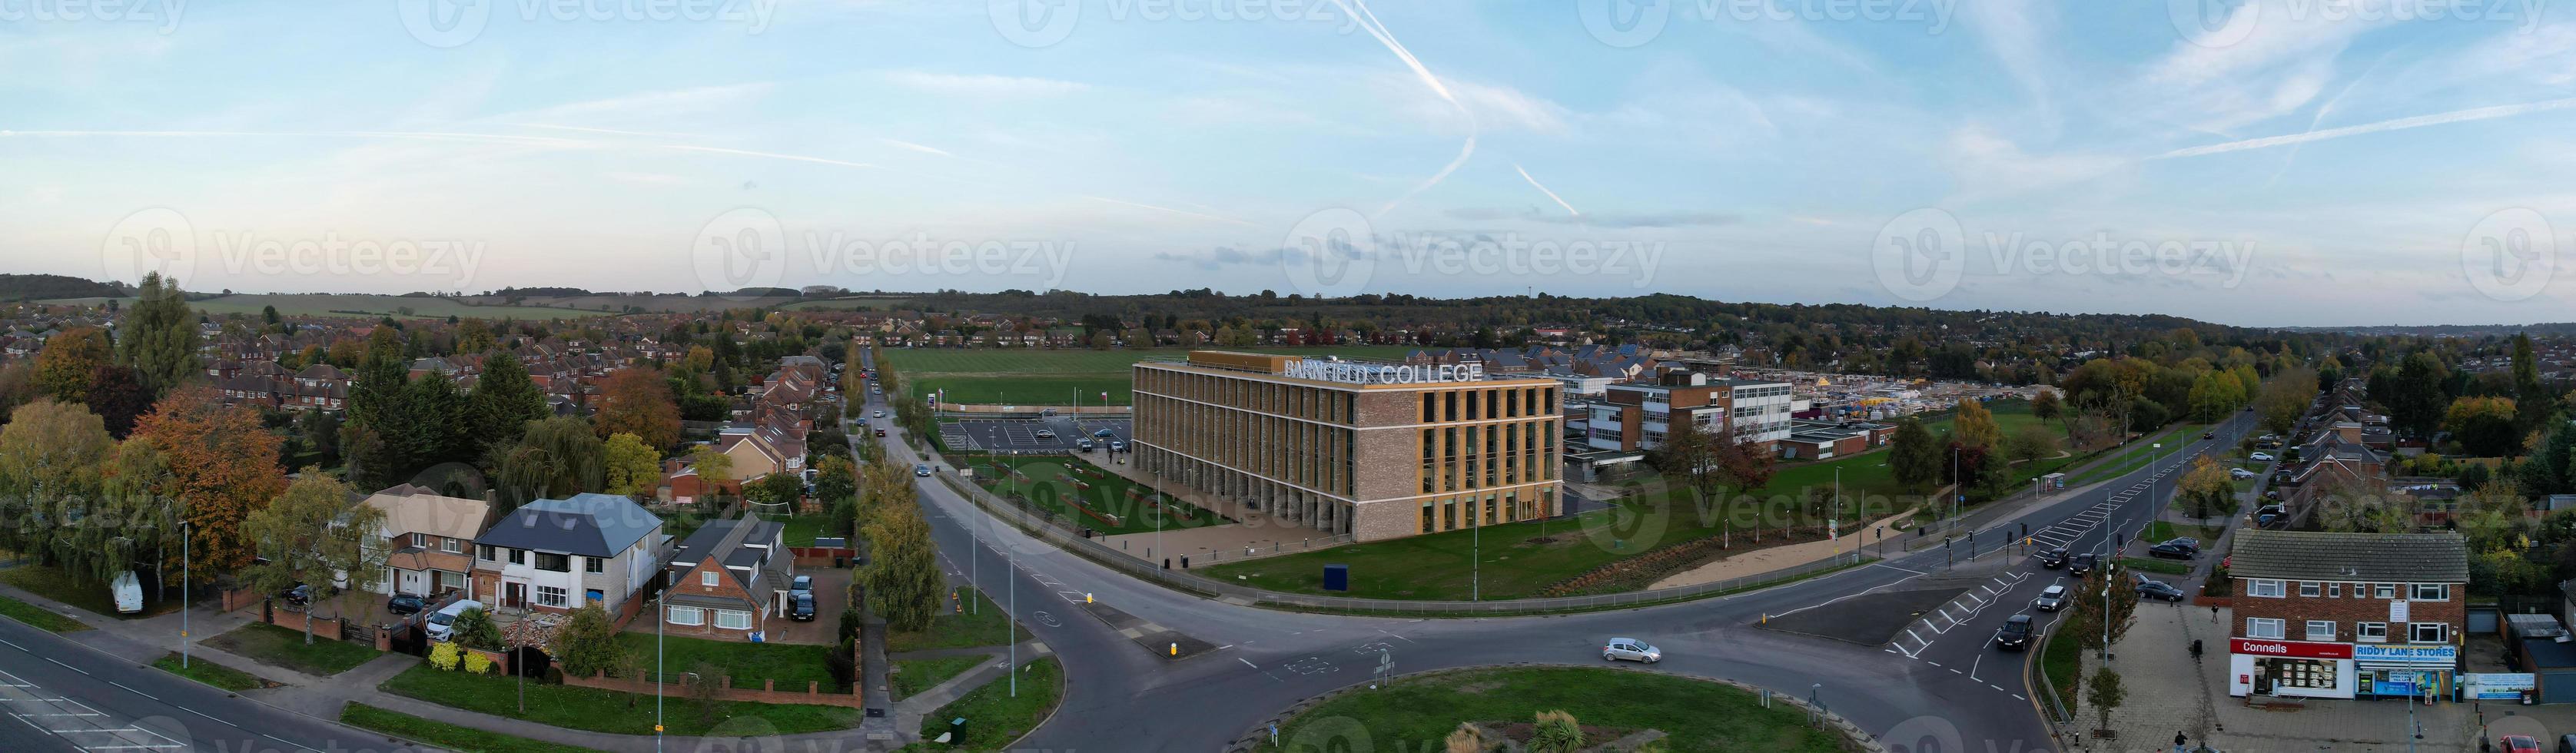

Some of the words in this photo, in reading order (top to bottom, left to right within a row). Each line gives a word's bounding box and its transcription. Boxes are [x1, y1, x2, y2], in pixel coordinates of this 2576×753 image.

[1284, 360, 1367, 384] BARNFIELD
[1379, 363, 1482, 384] COLLEGE
[2243, 642, 2287, 653] Connells
[2357, 646, 2386, 655] RIDDY
[2388, 648, 2413, 656] LANE
[2416, 648, 2455, 657] STORES
